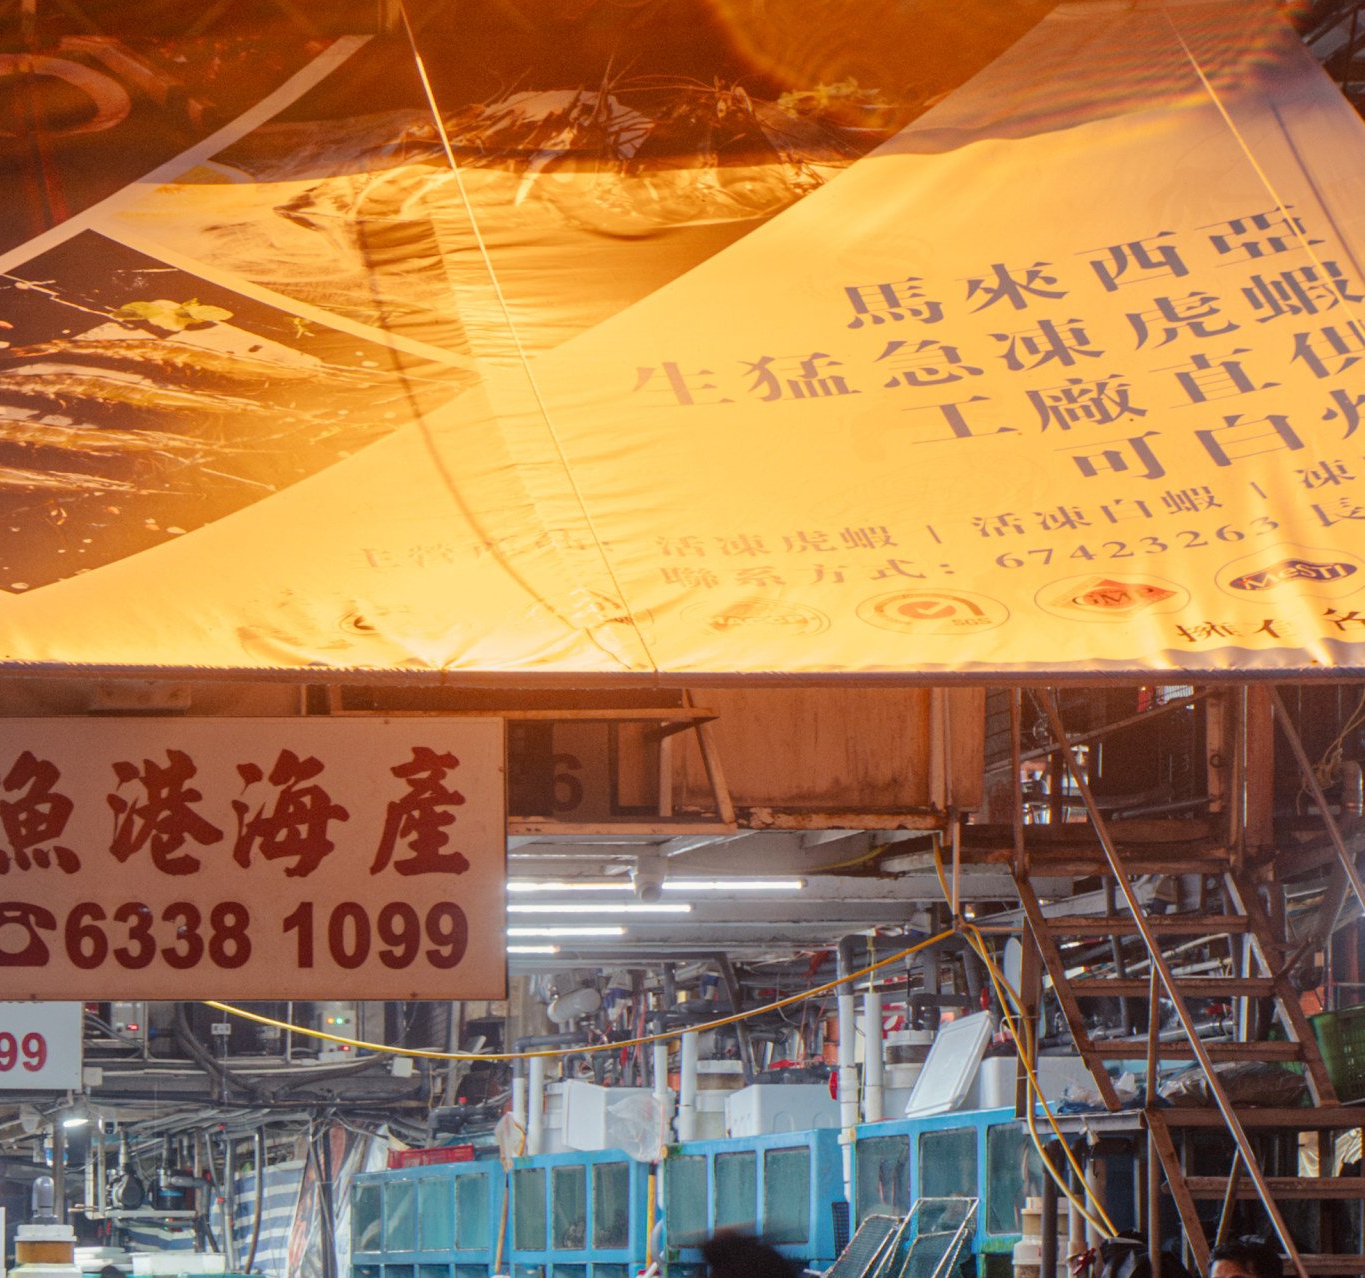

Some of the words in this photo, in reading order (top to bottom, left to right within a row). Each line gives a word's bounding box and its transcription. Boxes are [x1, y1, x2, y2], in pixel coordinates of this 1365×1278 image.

[843, 204, 1326, 330] 馬來西亞
[995, 516, 1280, 569] 67423263
[64, 901, 254, 970] 6338
[281, 901, 470, 970] 1099
